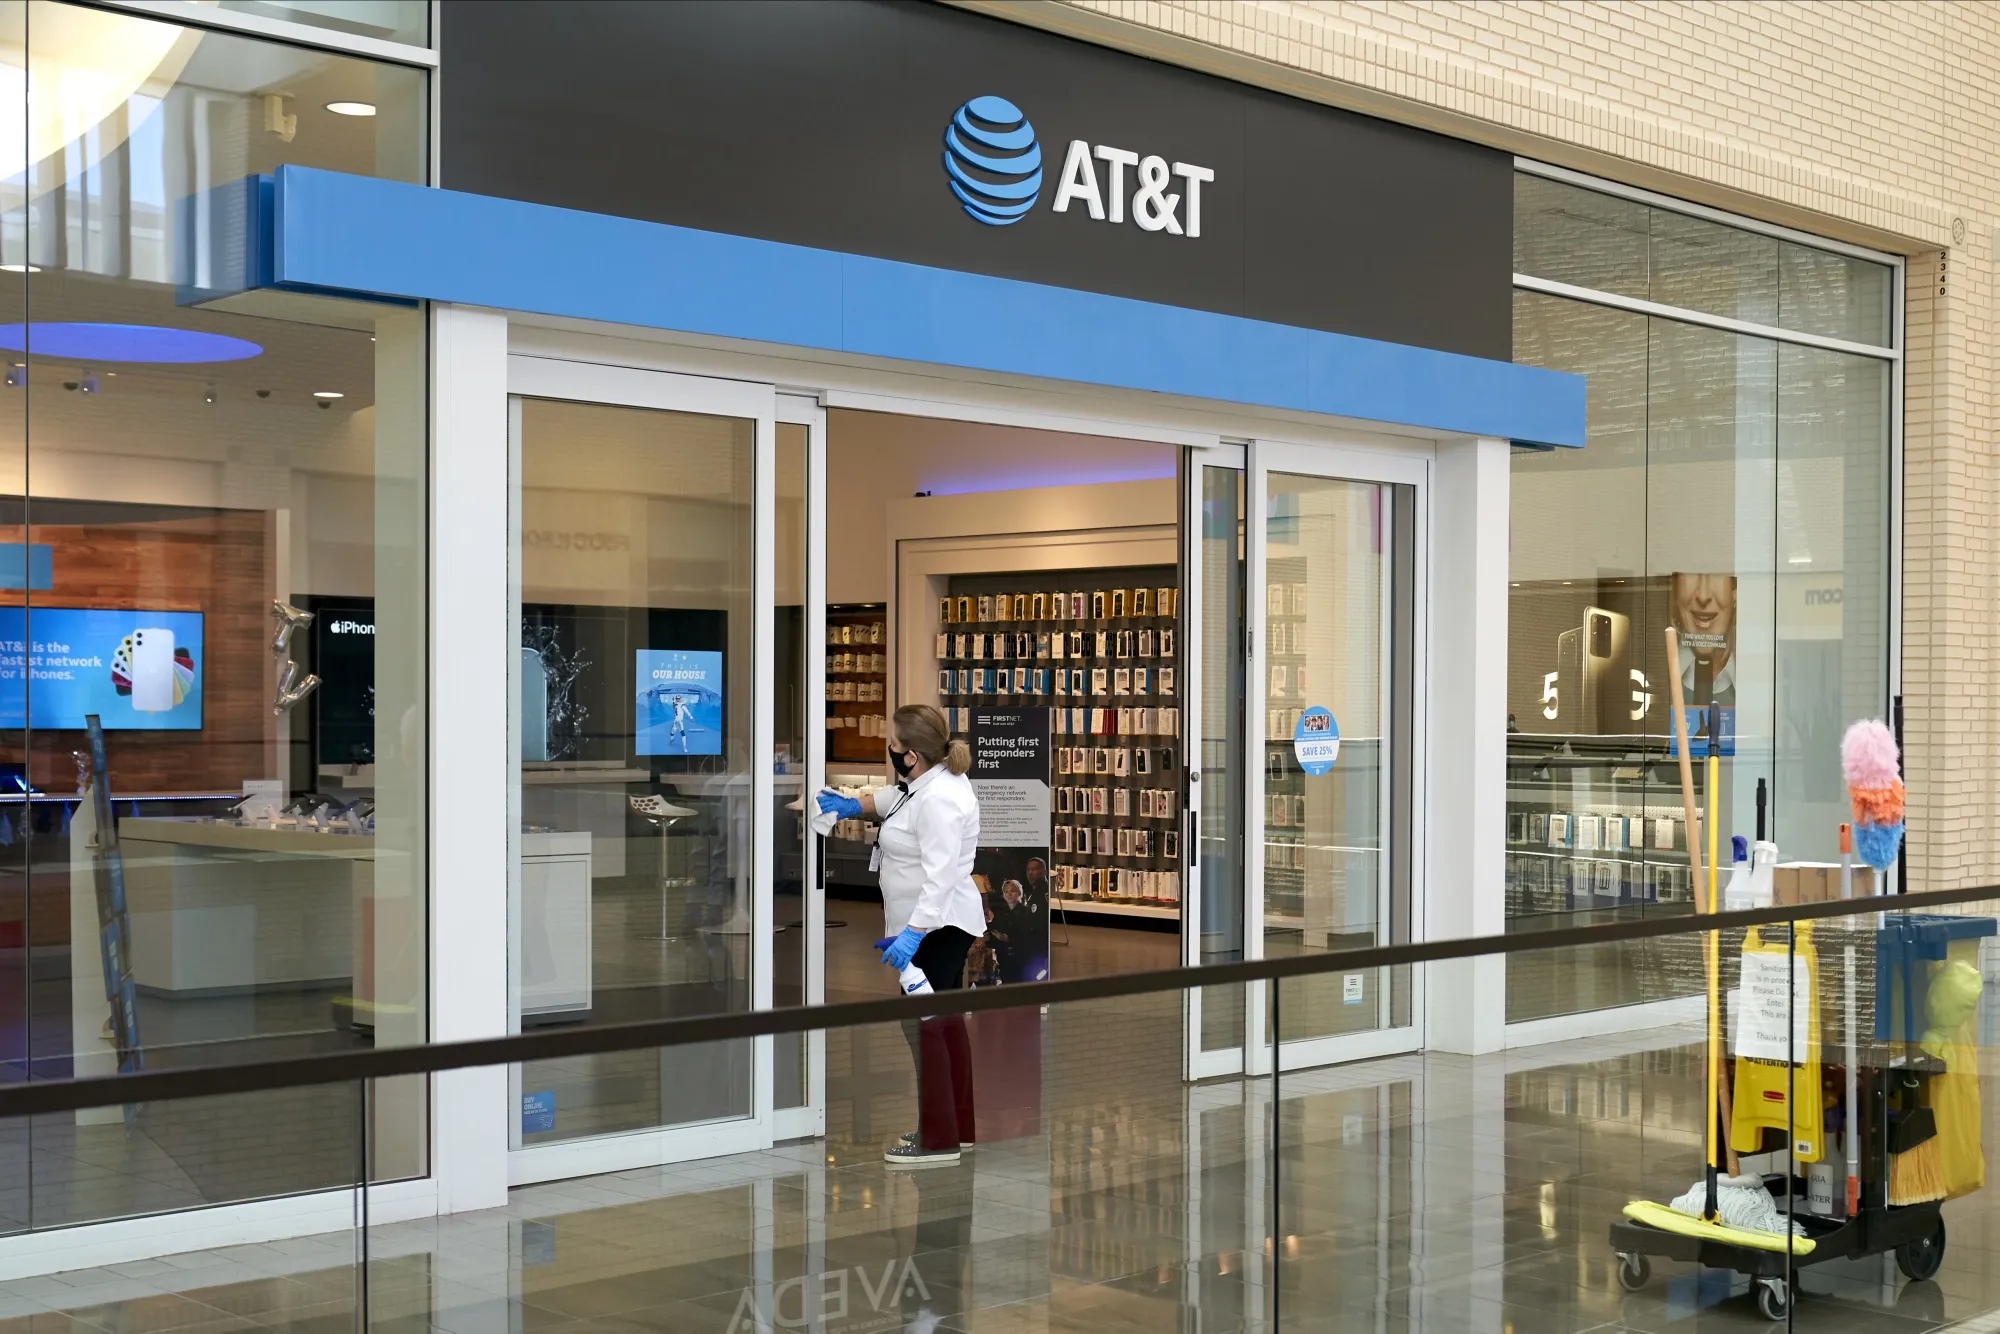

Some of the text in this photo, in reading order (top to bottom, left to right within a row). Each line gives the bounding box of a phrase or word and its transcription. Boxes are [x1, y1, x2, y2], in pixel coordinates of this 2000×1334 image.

[1053, 139, 1214, 238] AT&T
[341, 620, 375, 634] iPhon
[32, 641, 44, 653] is
[47, 641, 71, 653] the
[46, 655, 102, 667] network
[652, 669, 706, 680] OUR HOUSE
[978, 736, 1040, 748] Putting first
[978, 747, 1035, 759] responders
[1302, 746, 1332, 756] SAVE 25%
[978, 758, 1000, 769] first
[1760, 963, 1790, 974] Sanitizin
[1752, 985, 1775, 995] Please
[1775, 987, 1785, 996] Do
[1766, 998, 1785, 1008] Enter
[1760, 1009, 1790, 1020] This are
[1756, 1031, 1778, 1042] Thank
